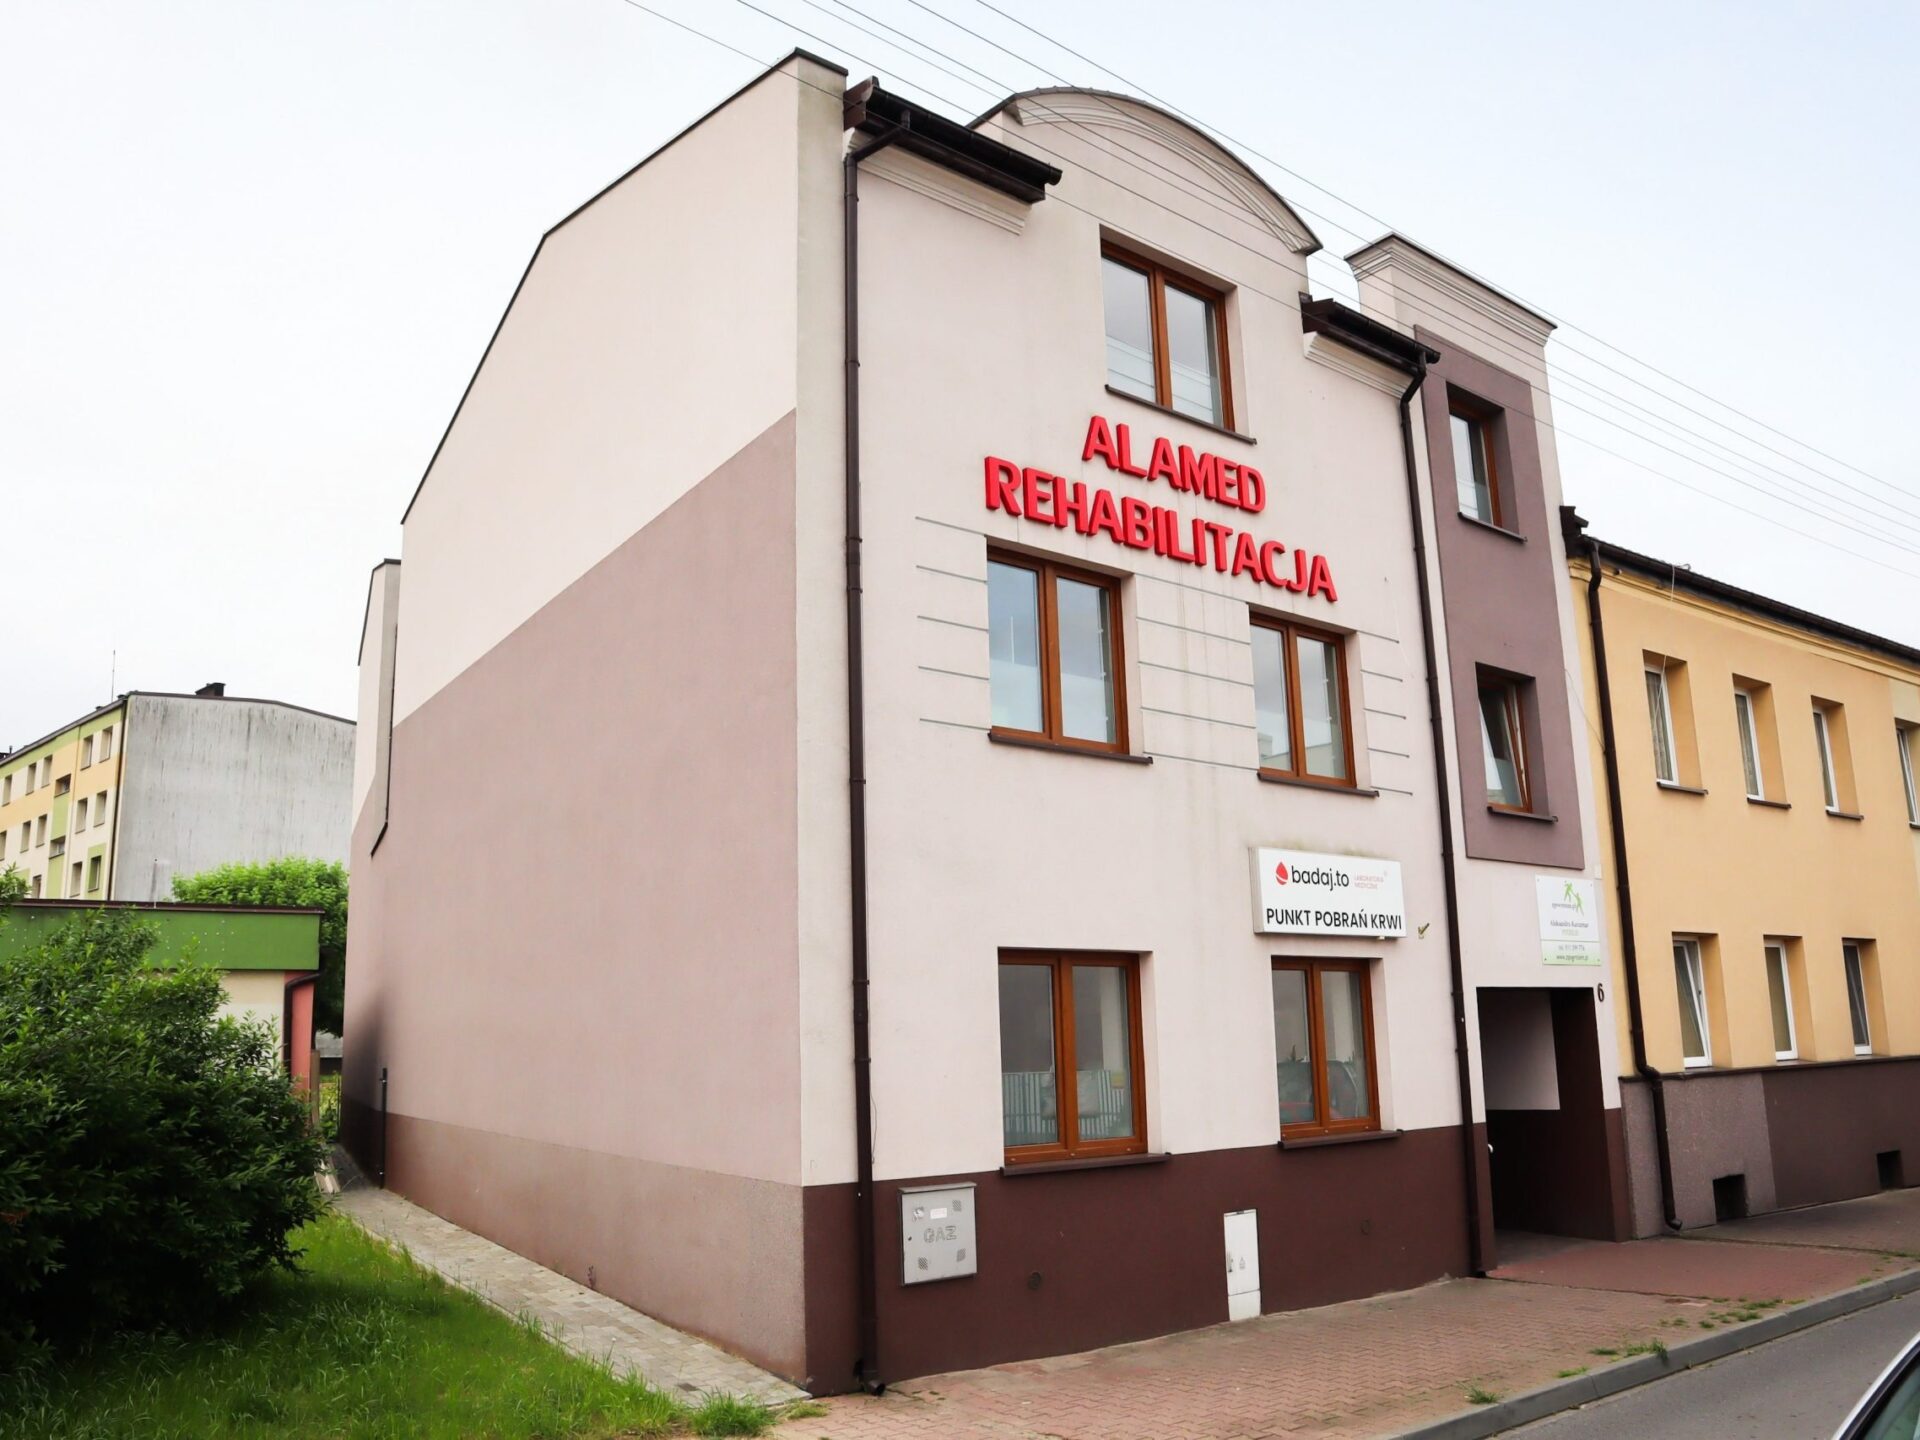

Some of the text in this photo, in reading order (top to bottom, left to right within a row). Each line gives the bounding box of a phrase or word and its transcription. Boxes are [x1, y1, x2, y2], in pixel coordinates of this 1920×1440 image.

[1082, 415, 1266, 513] ALAMED
[985, 456, 1338, 602] REHABILITACJA
[1291, 865, 1350, 891] badaj.to
[1266, 908, 1402, 930] PUNKT POBRAŃ KRWI
[1597, 982, 1605, 1002] 6
